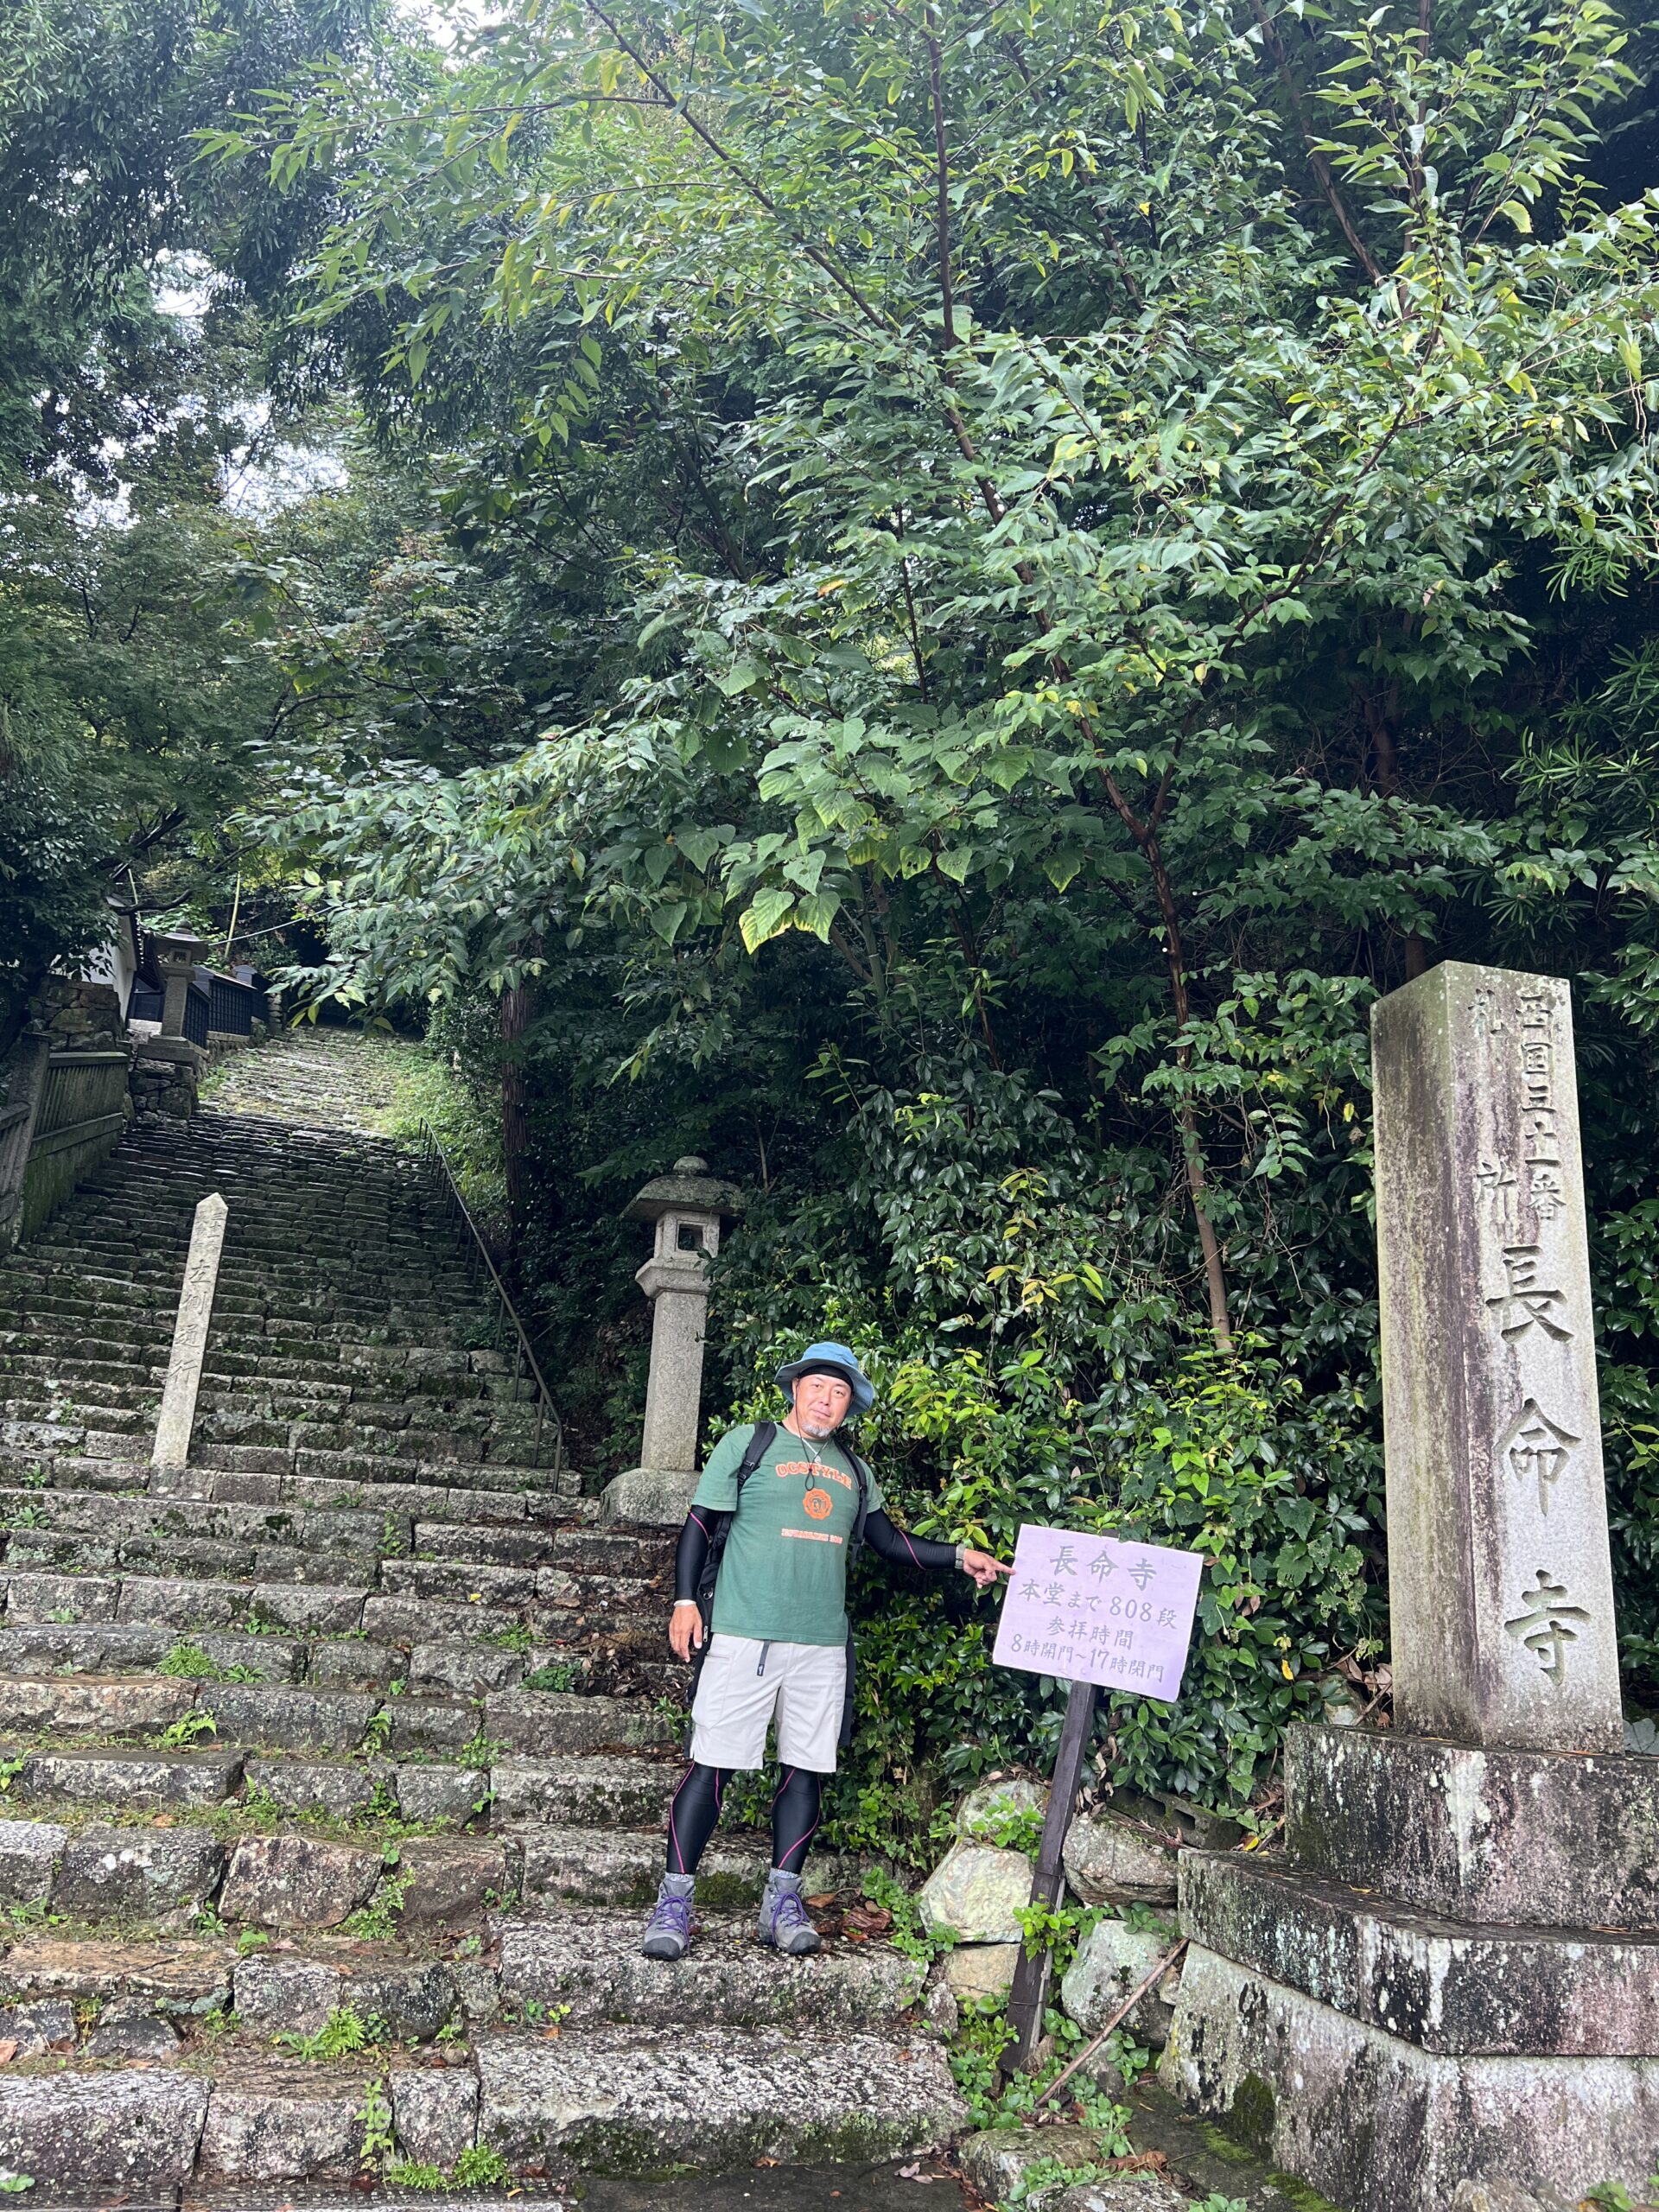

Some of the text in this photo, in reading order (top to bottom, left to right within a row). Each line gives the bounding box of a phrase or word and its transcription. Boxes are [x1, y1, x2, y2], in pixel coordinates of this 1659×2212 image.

[1485, 1244, 1592, 1686] 長命寺
[1049, 1545, 1157, 1592] 長命寺
[1046, 1615, 1135, 1650] 参拝時間
